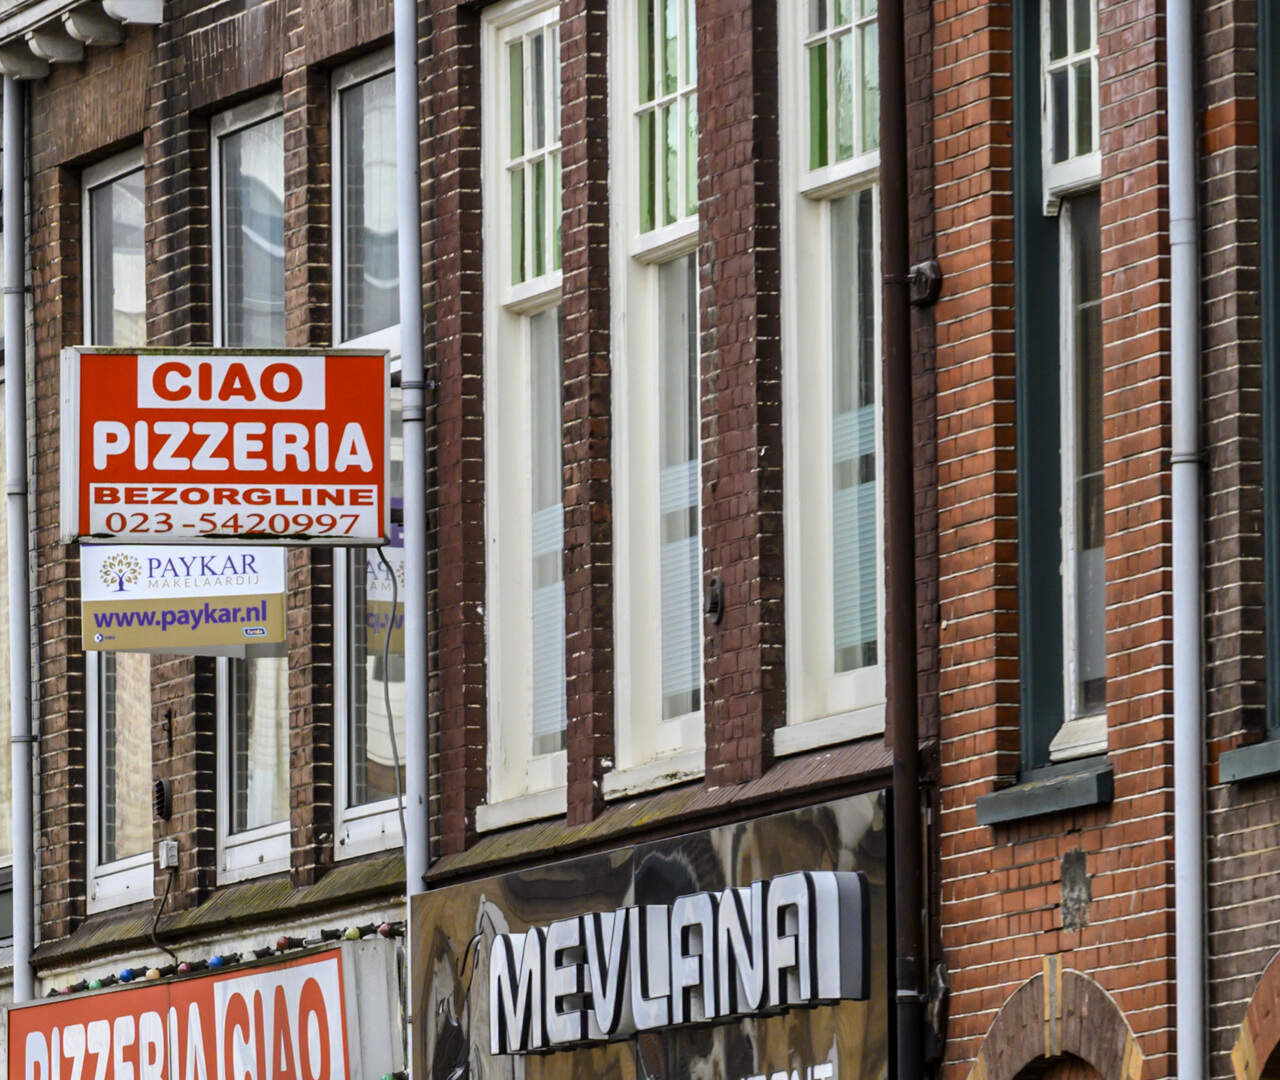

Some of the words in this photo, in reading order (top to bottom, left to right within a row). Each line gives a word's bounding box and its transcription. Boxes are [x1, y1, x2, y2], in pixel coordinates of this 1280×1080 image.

[152, 362, 303, 402] CIAO
[93, 420, 373, 473] PIZZERIA
[94, 488, 374, 506] BEZORGLINE
[148, 554, 258, 578] PAYKAR
[148, 576, 260, 588] MAKELAARDIJ
[94, 601, 267, 631] www.paykar.nl
[489, 871, 815, 1055] MEVLANA
